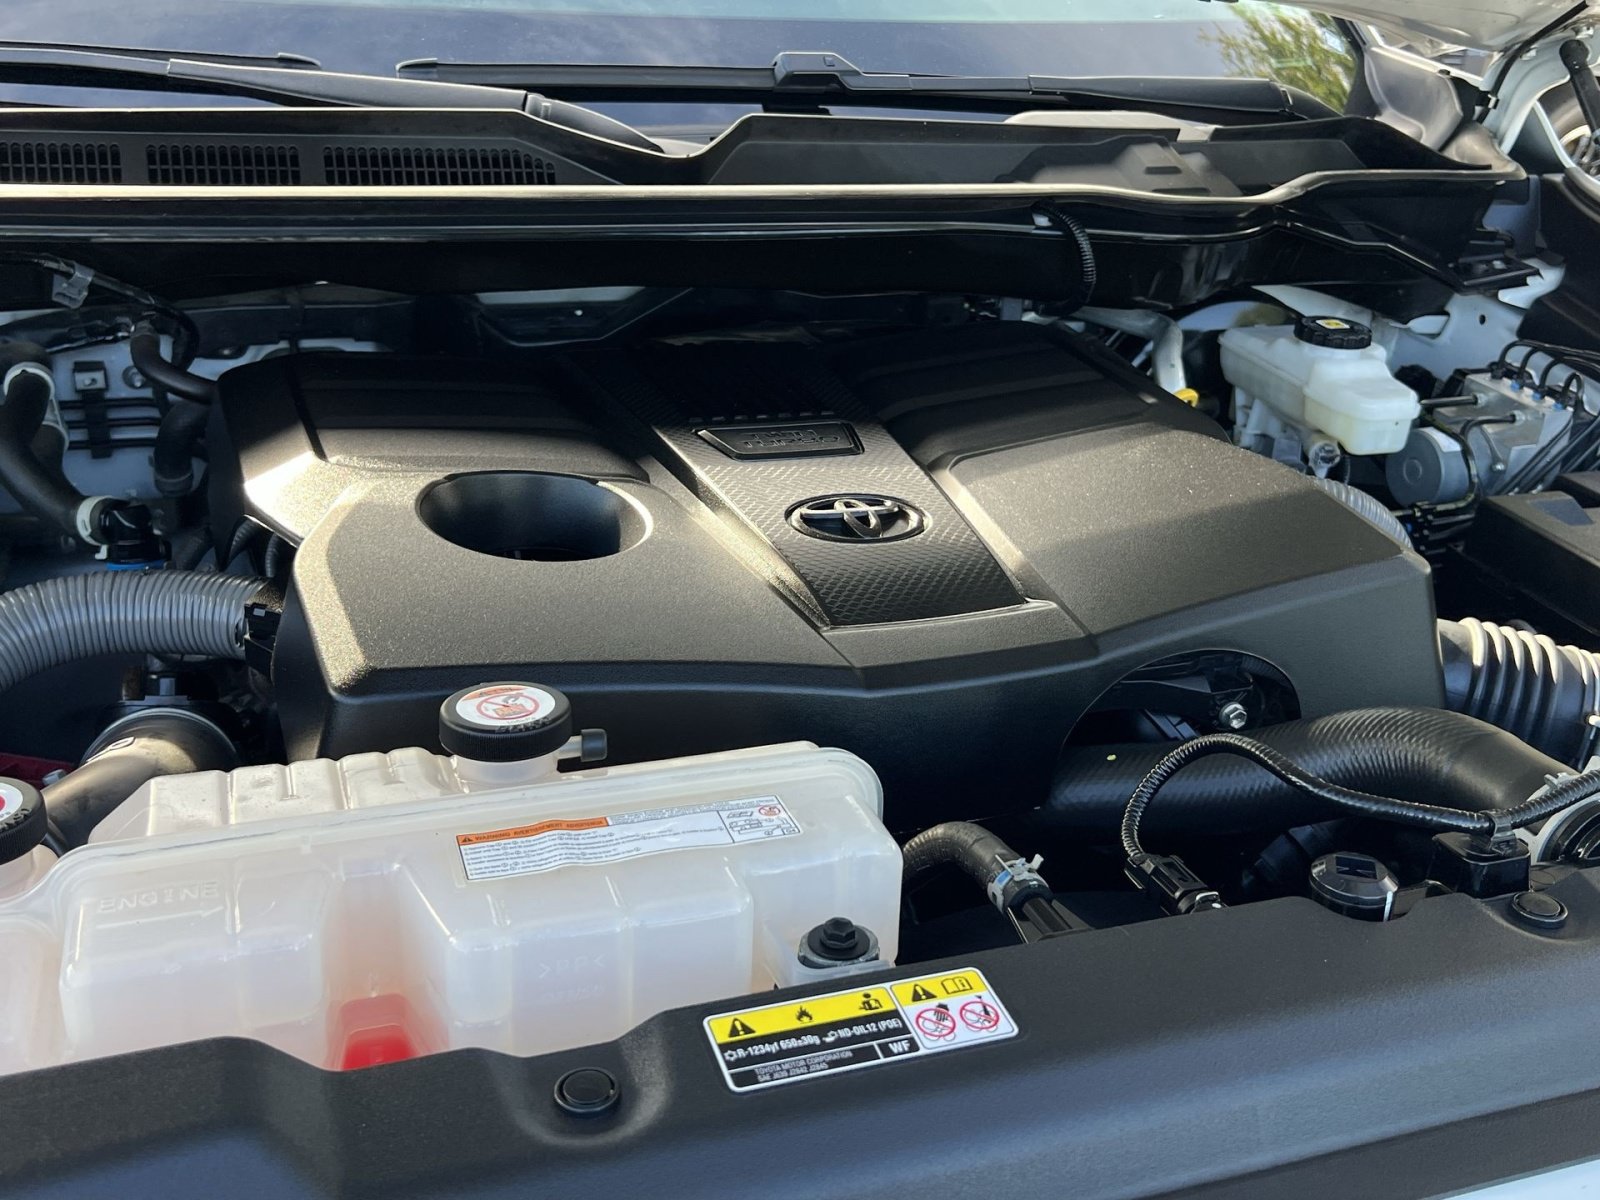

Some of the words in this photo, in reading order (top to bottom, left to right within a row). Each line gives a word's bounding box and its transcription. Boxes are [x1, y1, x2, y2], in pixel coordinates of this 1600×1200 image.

[97, 881, 220, 913] ENGINE
[737, 1041, 779, 1059] R-1234yf
[780, 1034, 820, 1051] 650±30g
[838, 1022, 877, 1038] ND-OIL12
[879, 1018, 902, 1032] (POE)
[889, 1040, 911, 1054] WF
[754, 1062, 780, 1075] TOYOTA
[781, 1058, 806, 1071] MOTOR
[806, 1051, 853, 1066] CORPORATION
